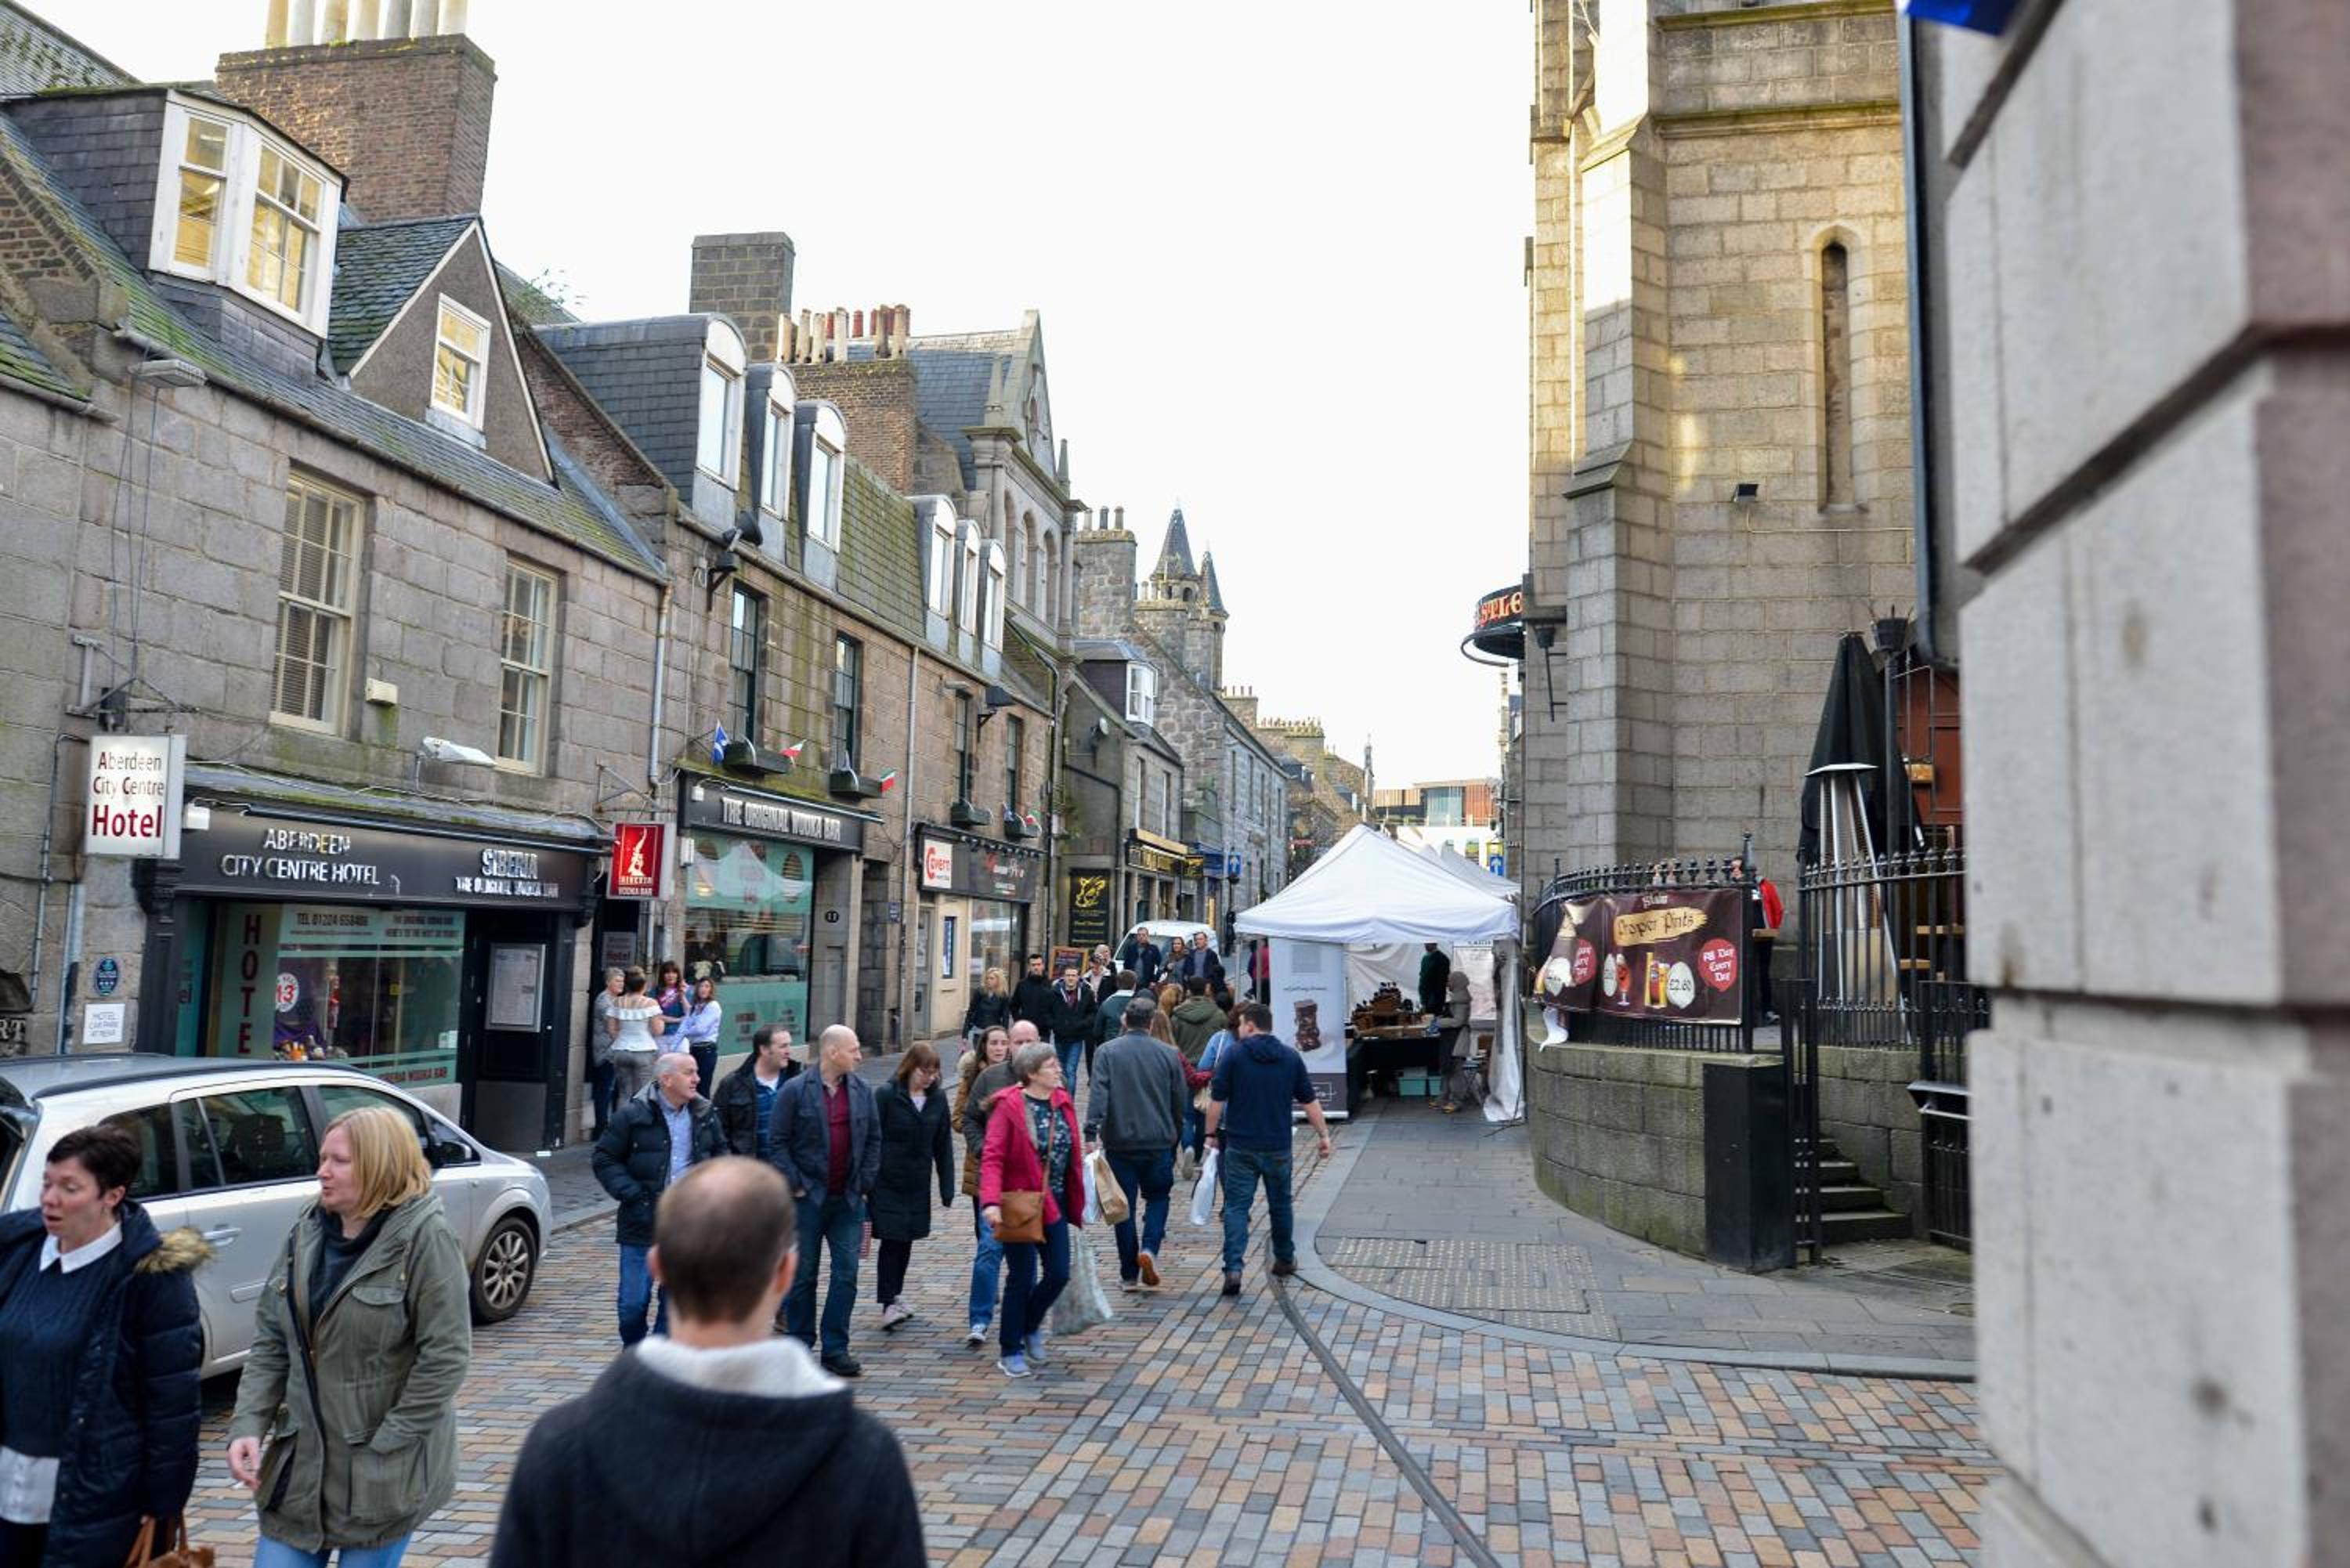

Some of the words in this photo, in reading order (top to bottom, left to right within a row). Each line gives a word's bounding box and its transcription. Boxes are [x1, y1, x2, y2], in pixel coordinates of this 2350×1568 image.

[98, 751, 162, 771] Aberdeen
[93, 776, 117, 799] City
[122, 776, 164, 796] Centre
[92, 804, 163, 838] Hotel
[722, 797, 743, 825] THE
[745, 801, 790, 833] ORIGINAL
[263, 828, 352, 855] ABERDEEN
[221, 854, 262, 876] CITY
[265, 858, 328, 882] CENTRE
[331, 863, 381, 885] HOTEL
[482, 848, 538, 879] SIBERIA
[1662, 911, 1694, 934] Pints
[238, 913, 262, 1054] HOTE
